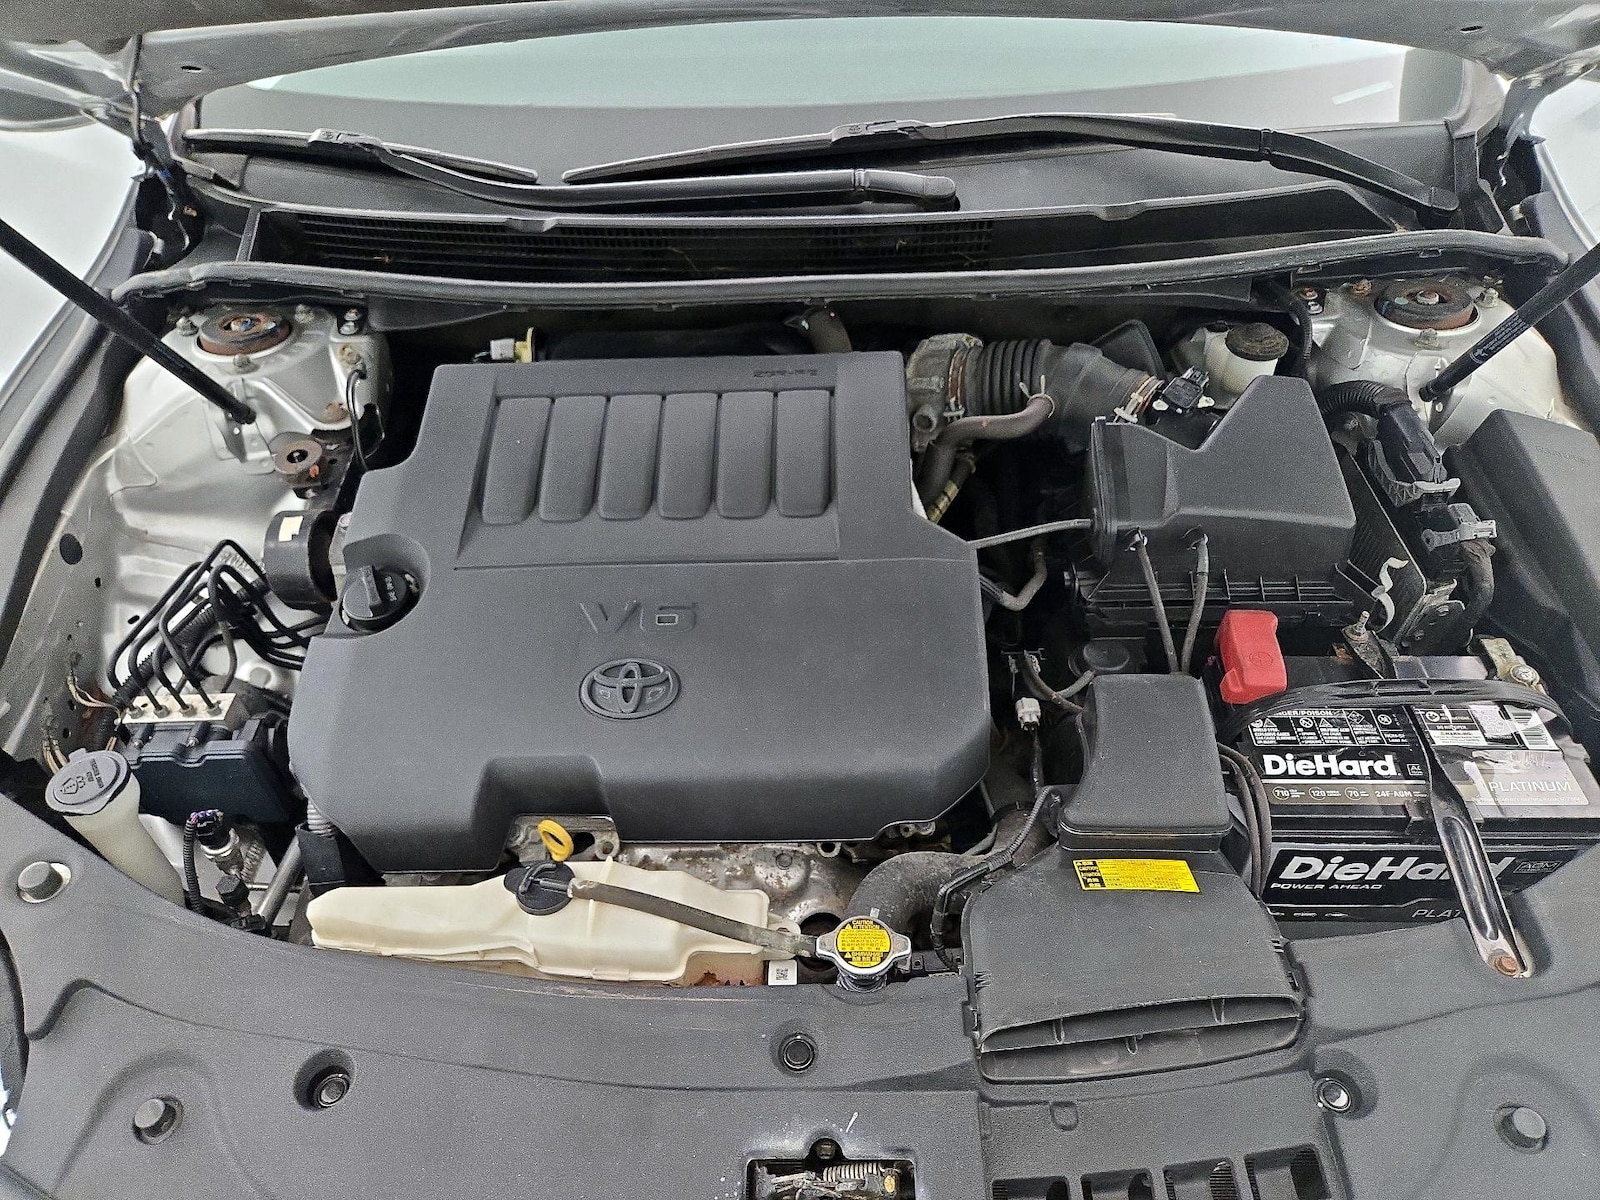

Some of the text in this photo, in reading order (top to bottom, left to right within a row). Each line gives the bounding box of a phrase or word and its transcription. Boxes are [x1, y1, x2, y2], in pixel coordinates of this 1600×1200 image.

[580, 600, 697, 633] V6
[1488, 781, 1572, 792] PLATINUM
[1275, 789, 1290, 797] 710
[1270, 882, 1325, 890] POWER
